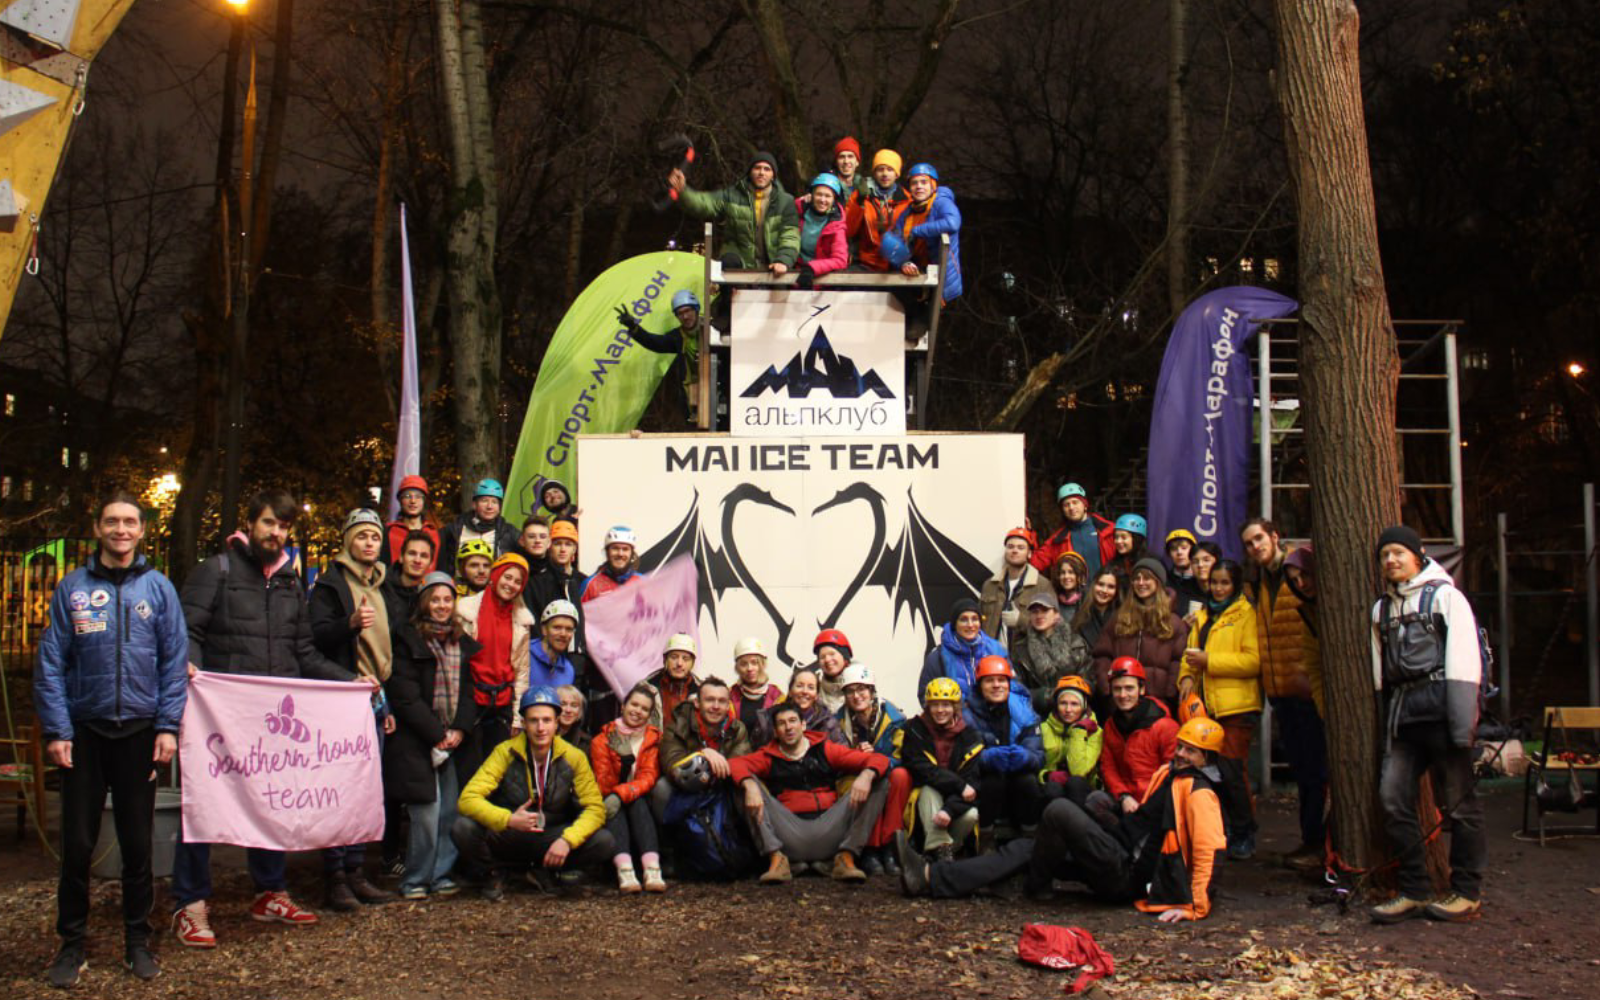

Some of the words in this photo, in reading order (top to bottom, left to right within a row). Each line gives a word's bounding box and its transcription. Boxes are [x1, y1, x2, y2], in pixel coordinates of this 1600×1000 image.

[744, 400, 888, 432] альпклуб
[665, 444, 740, 473] MAI
[749, 444, 811, 472] ICE
[821, 442, 939, 471] TEAM
[261, 782, 340, 811] team
